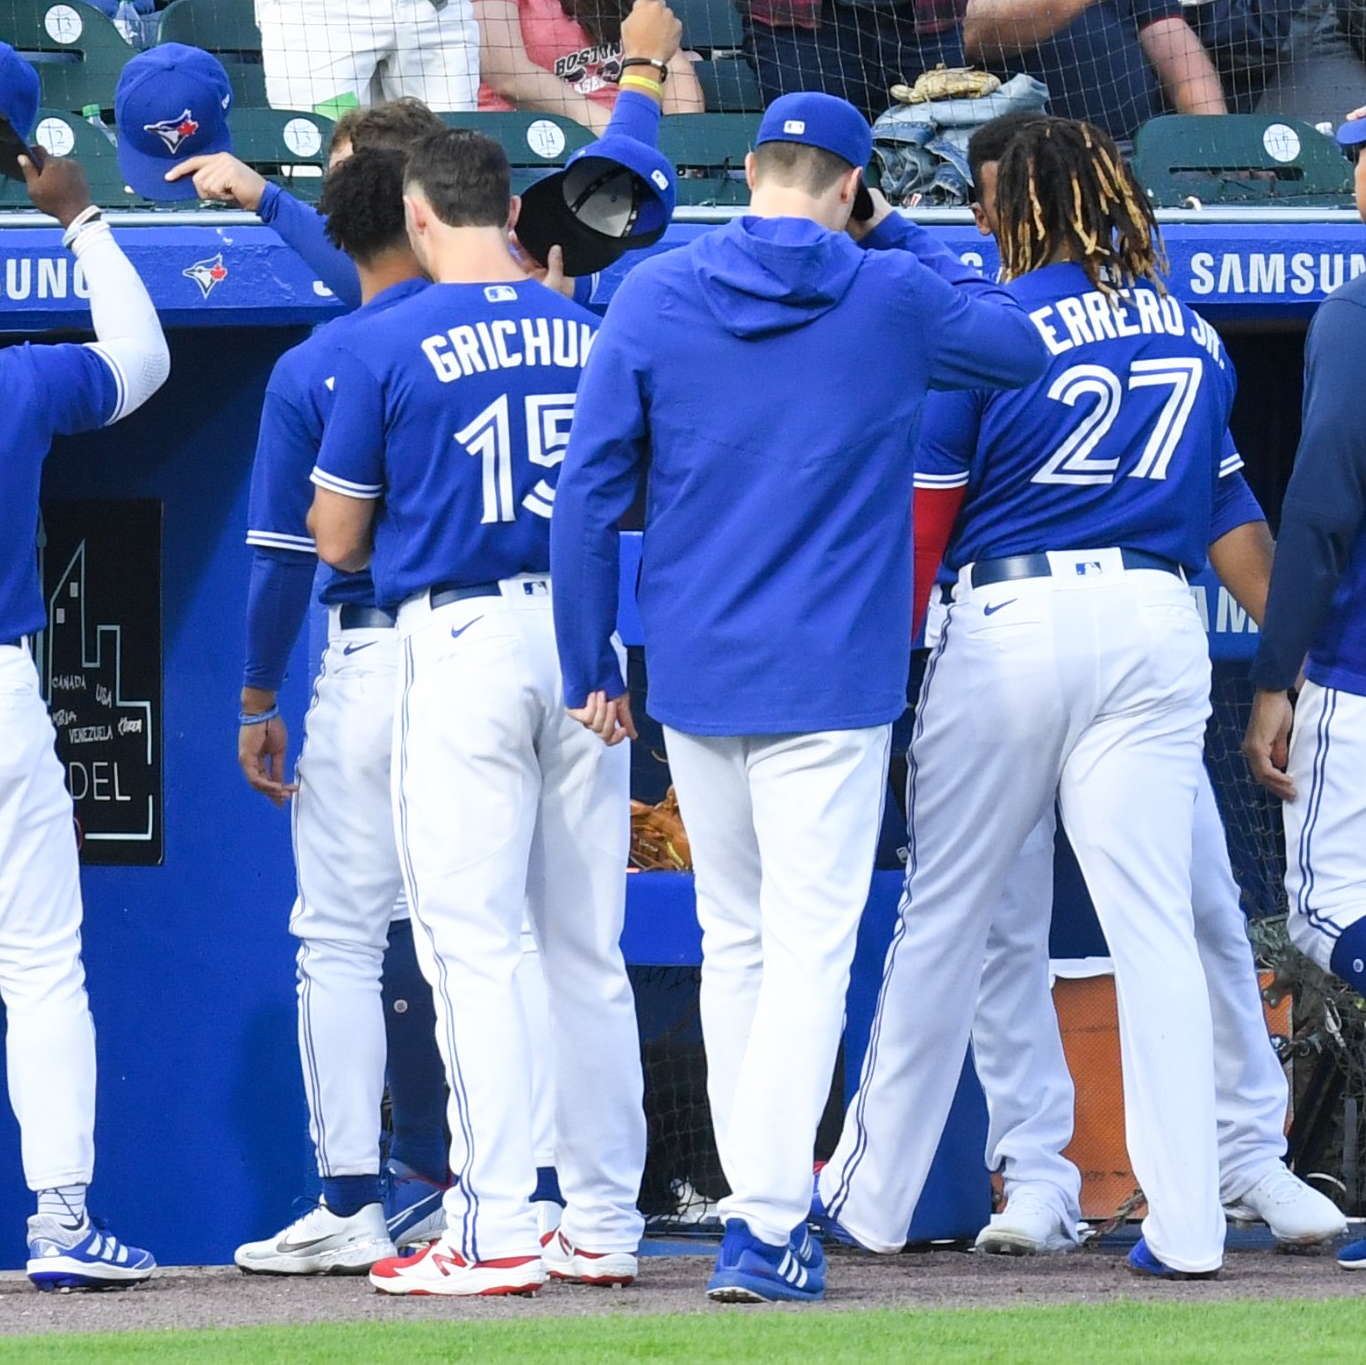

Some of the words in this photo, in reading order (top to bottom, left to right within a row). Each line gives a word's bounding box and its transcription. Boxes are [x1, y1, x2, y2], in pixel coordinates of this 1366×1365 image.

[1030, 367, 1203, 485] 27
[455, 392, 576, 524] 15
[52, 674, 87, 691] CANADA
[95, 684, 113, 710] USA
[68, 724, 113, 744] VENEZUELA
